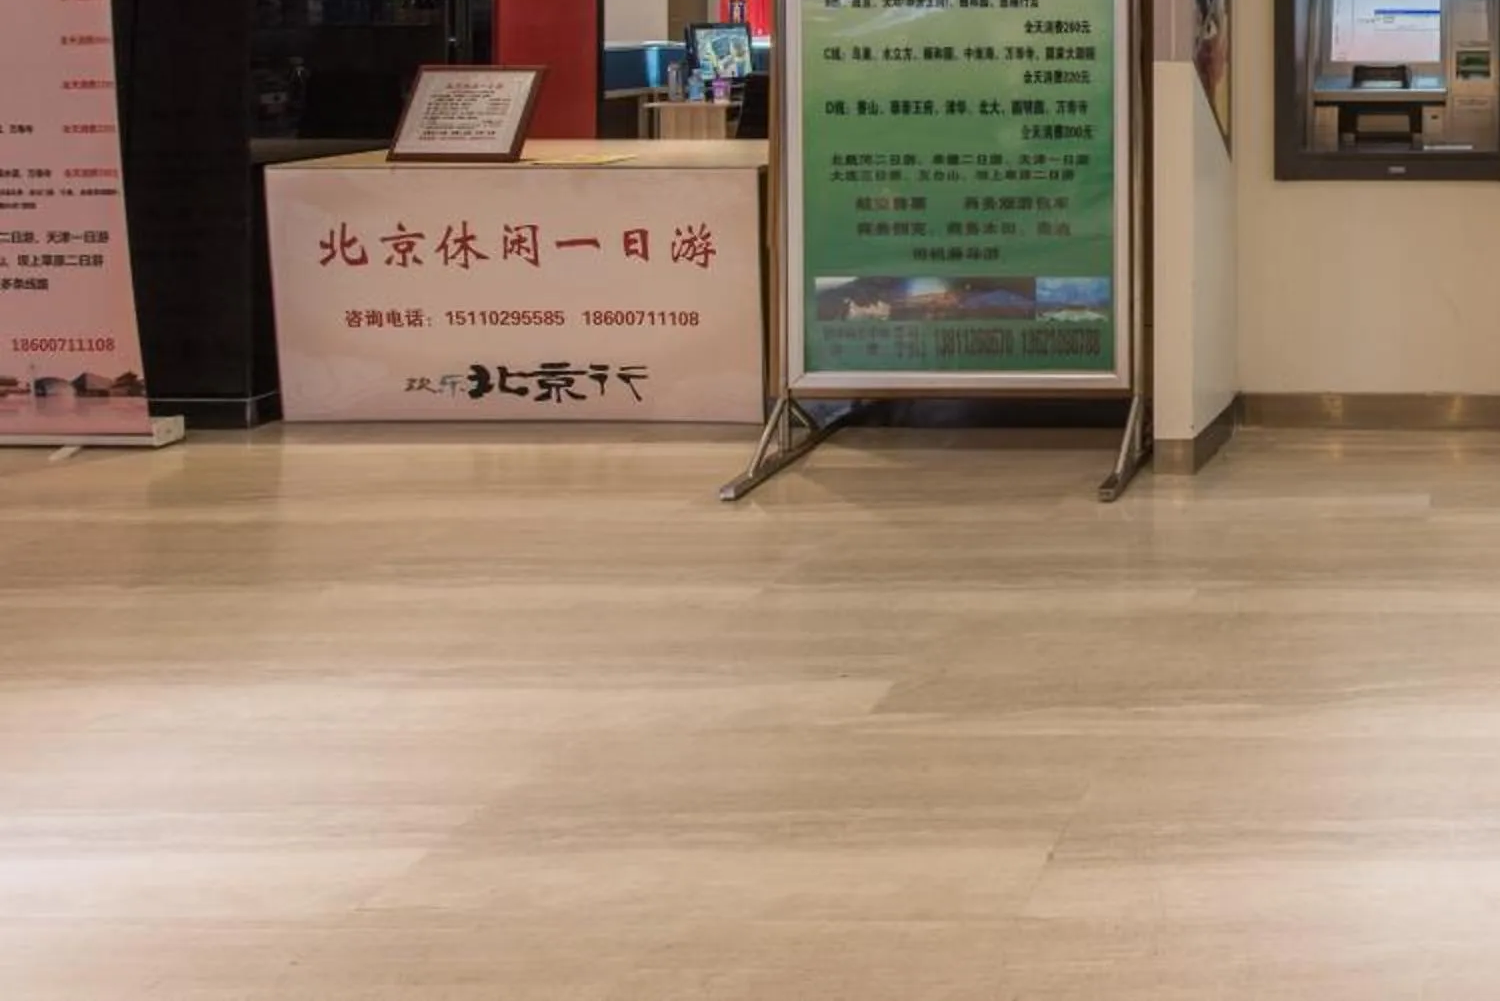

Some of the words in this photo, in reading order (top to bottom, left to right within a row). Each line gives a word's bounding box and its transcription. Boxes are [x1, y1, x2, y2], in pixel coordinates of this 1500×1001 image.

[318, 220, 718, 270] 北京休闲一日游
[444, 309, 566, 327] 15110295585
[581, 309, 701, 327] 18600711108
[12, 337, 116, 353] 18600711108
